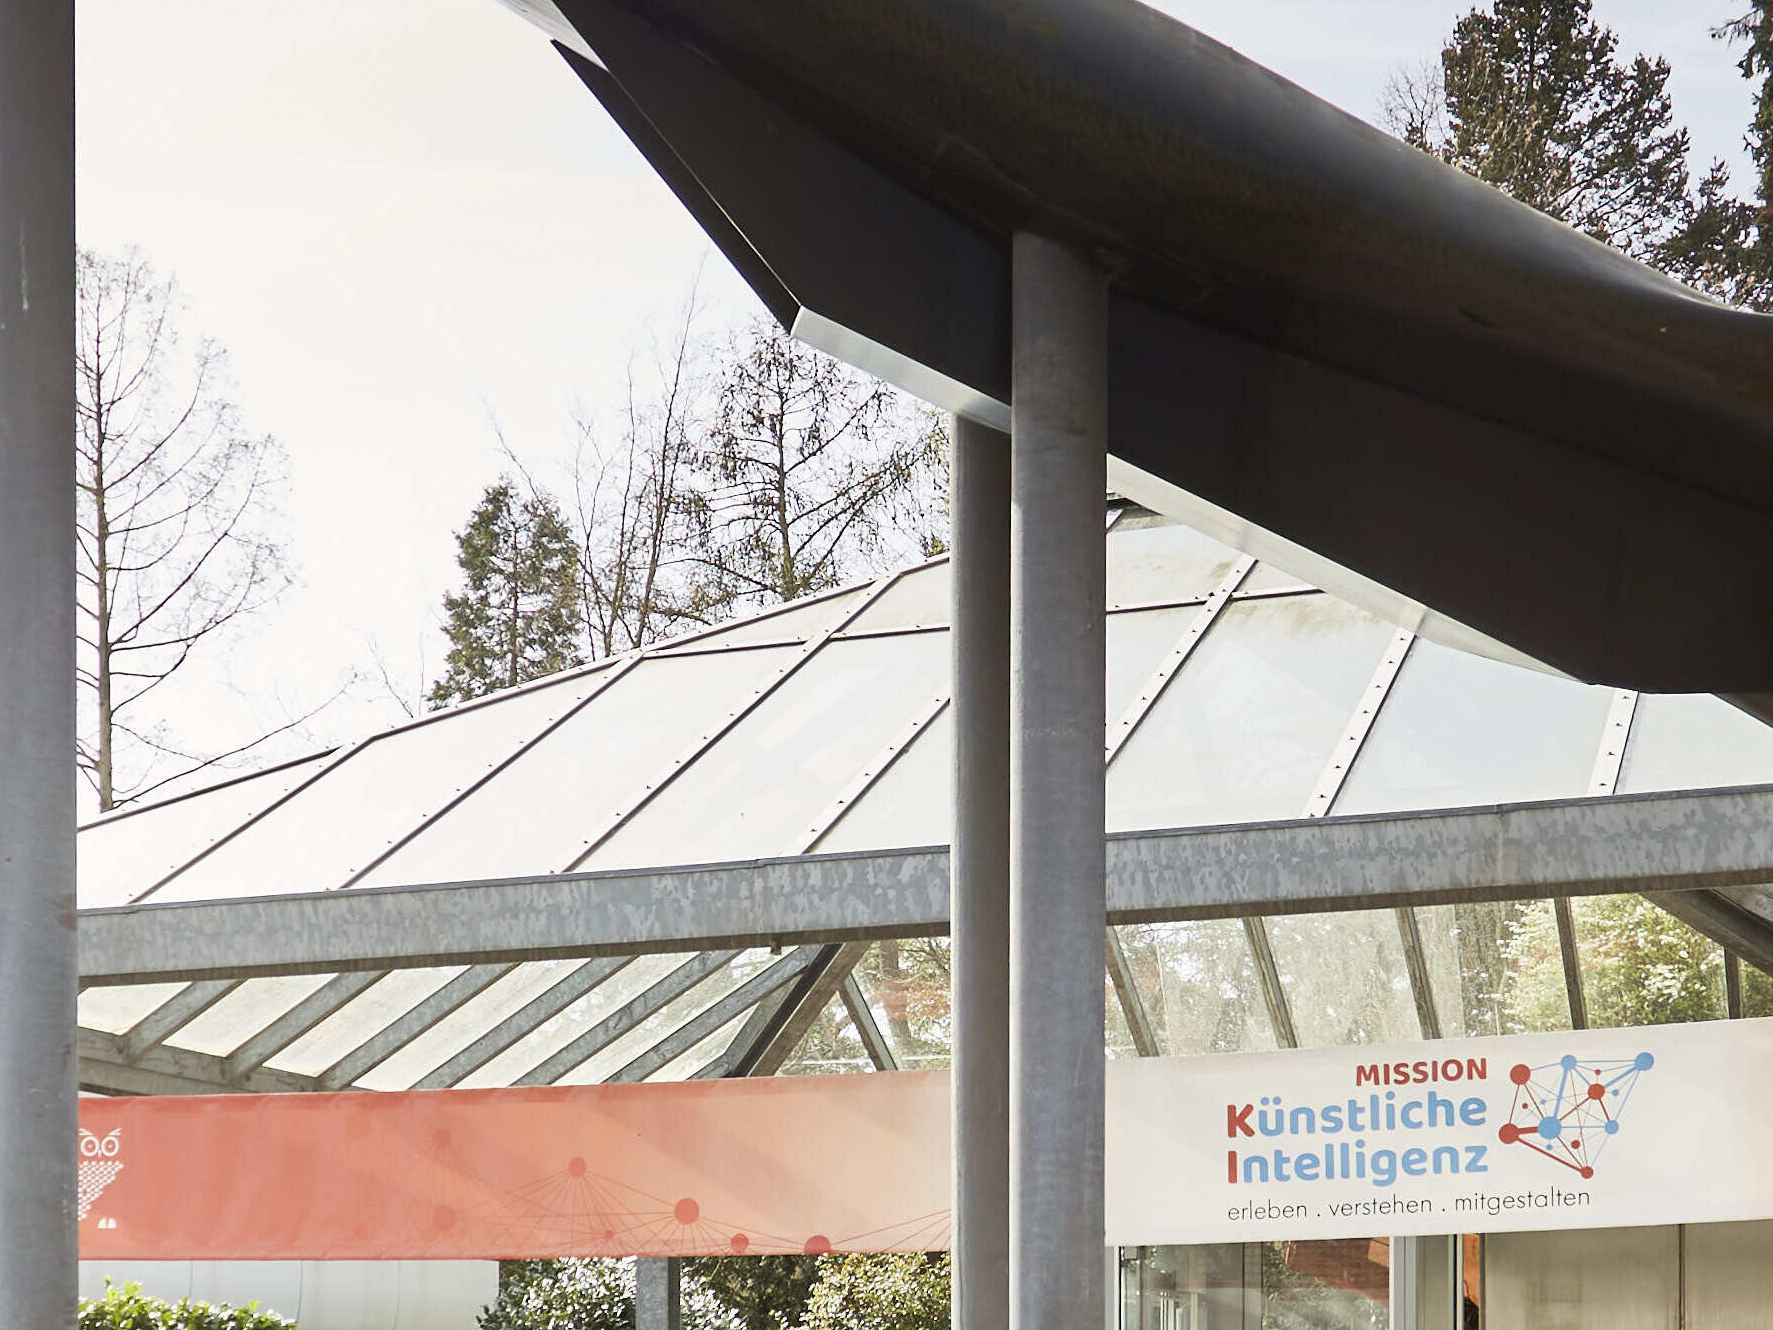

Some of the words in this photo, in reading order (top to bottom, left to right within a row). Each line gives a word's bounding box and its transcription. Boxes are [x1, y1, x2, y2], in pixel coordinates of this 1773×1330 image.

[1356, 1058, 1488, 1086] MISSION
[1227, 1091, 1488, 1138] Künstliche
[1228, 1140, 1489, 1187] Intelligenz
[1228, 1197, 1308, 1221] erleben
[1329, 1193, 1433, 1219] verstehen
[1455, 1187, 1591, 1216] mitgestalten
